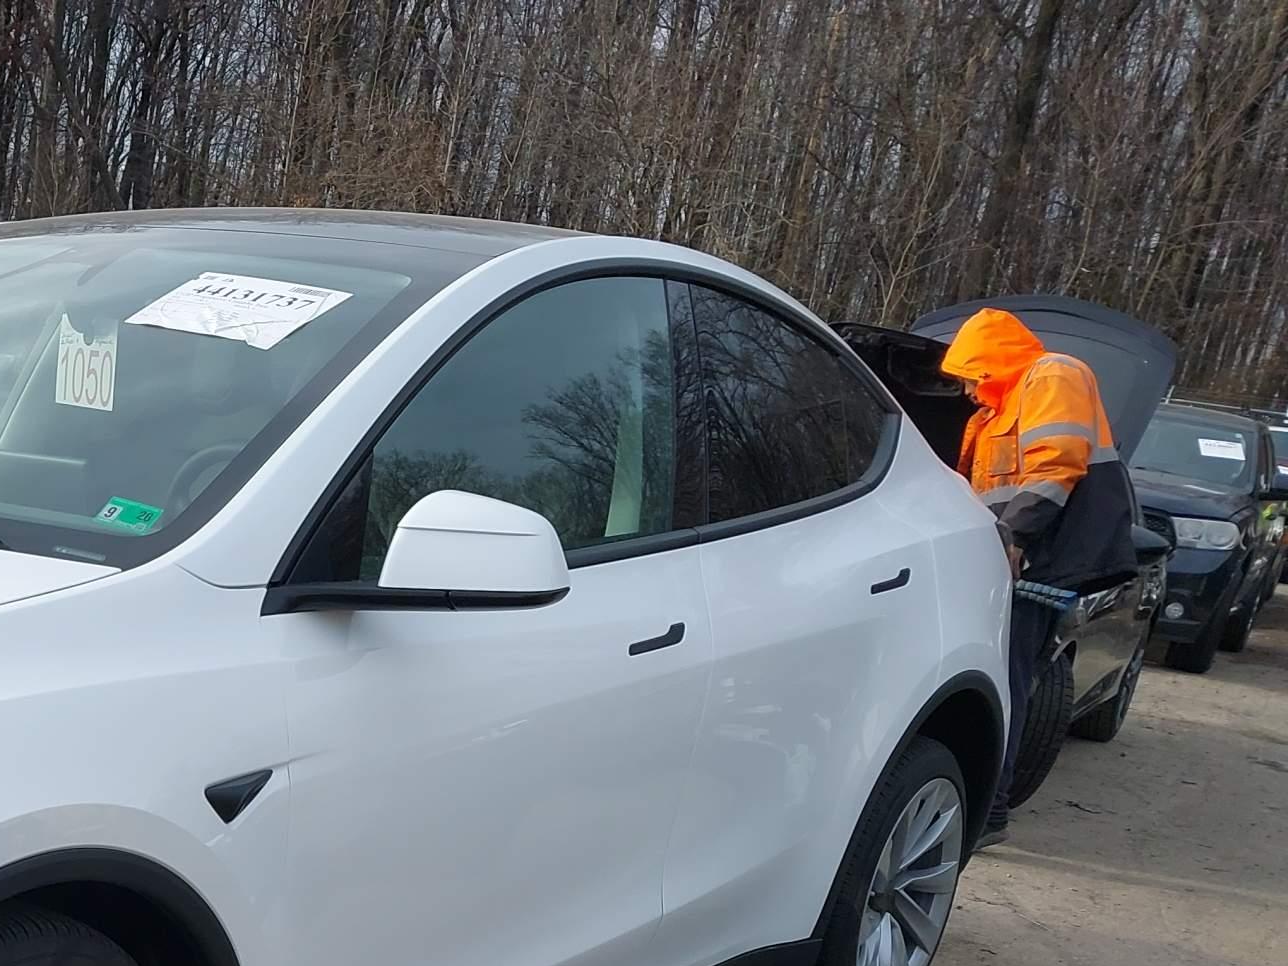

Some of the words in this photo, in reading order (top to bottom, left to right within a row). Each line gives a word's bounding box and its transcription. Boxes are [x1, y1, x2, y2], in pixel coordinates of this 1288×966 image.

[193, 284, 316, 310] 44131737
[61, 346, 113, 408] 1050
[103, 506, 118, 518] 9
